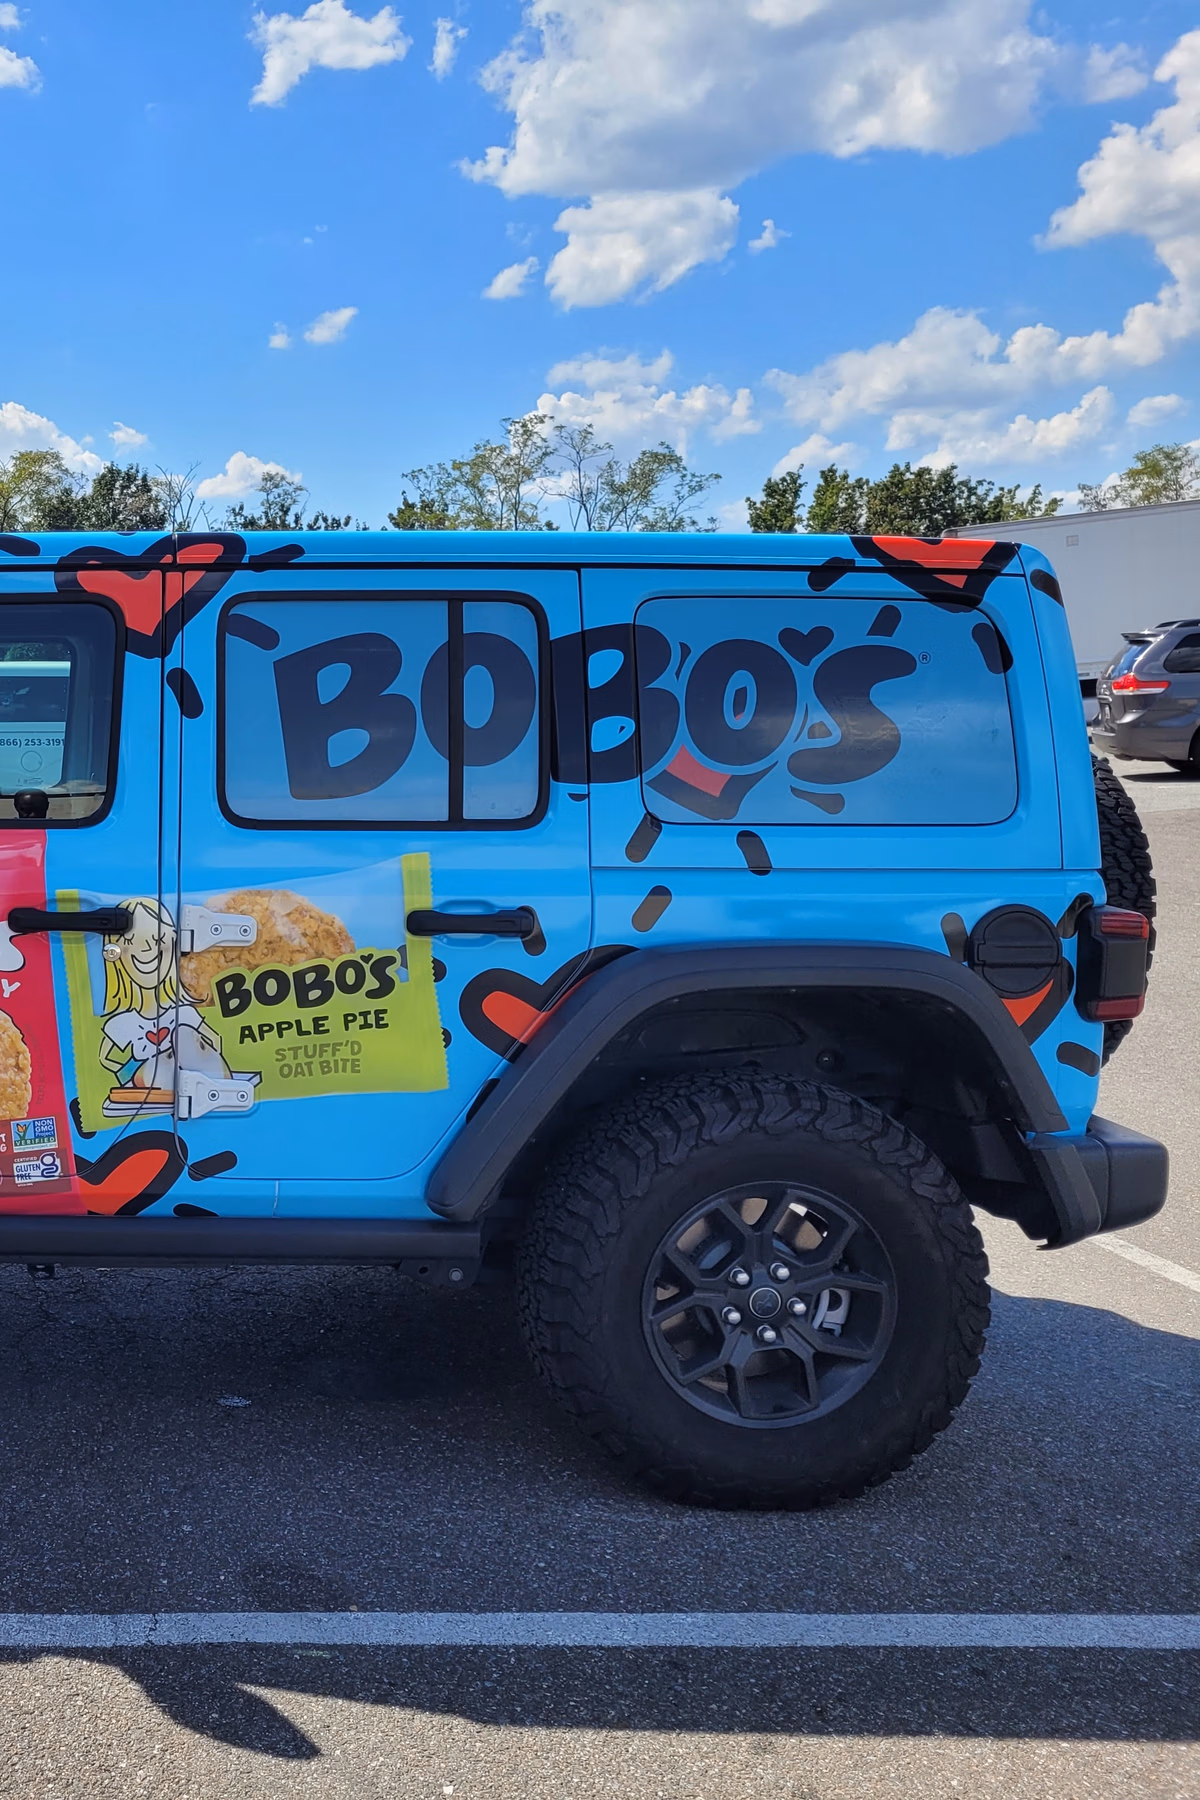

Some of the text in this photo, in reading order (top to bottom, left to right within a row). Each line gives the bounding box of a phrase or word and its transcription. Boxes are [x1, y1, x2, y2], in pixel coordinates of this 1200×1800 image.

[239, 1009, 389, 1045] APPLE PIE
[275, 1040, 362, 1063] STUFF'D
[279, 1058, 361, 1079] OAT BITE
[34, 1119, 53, 1127] NON
[15, 1137, 55, 1146] VERIFIED
[15, 1163, 41, 1173] GLUTEN
